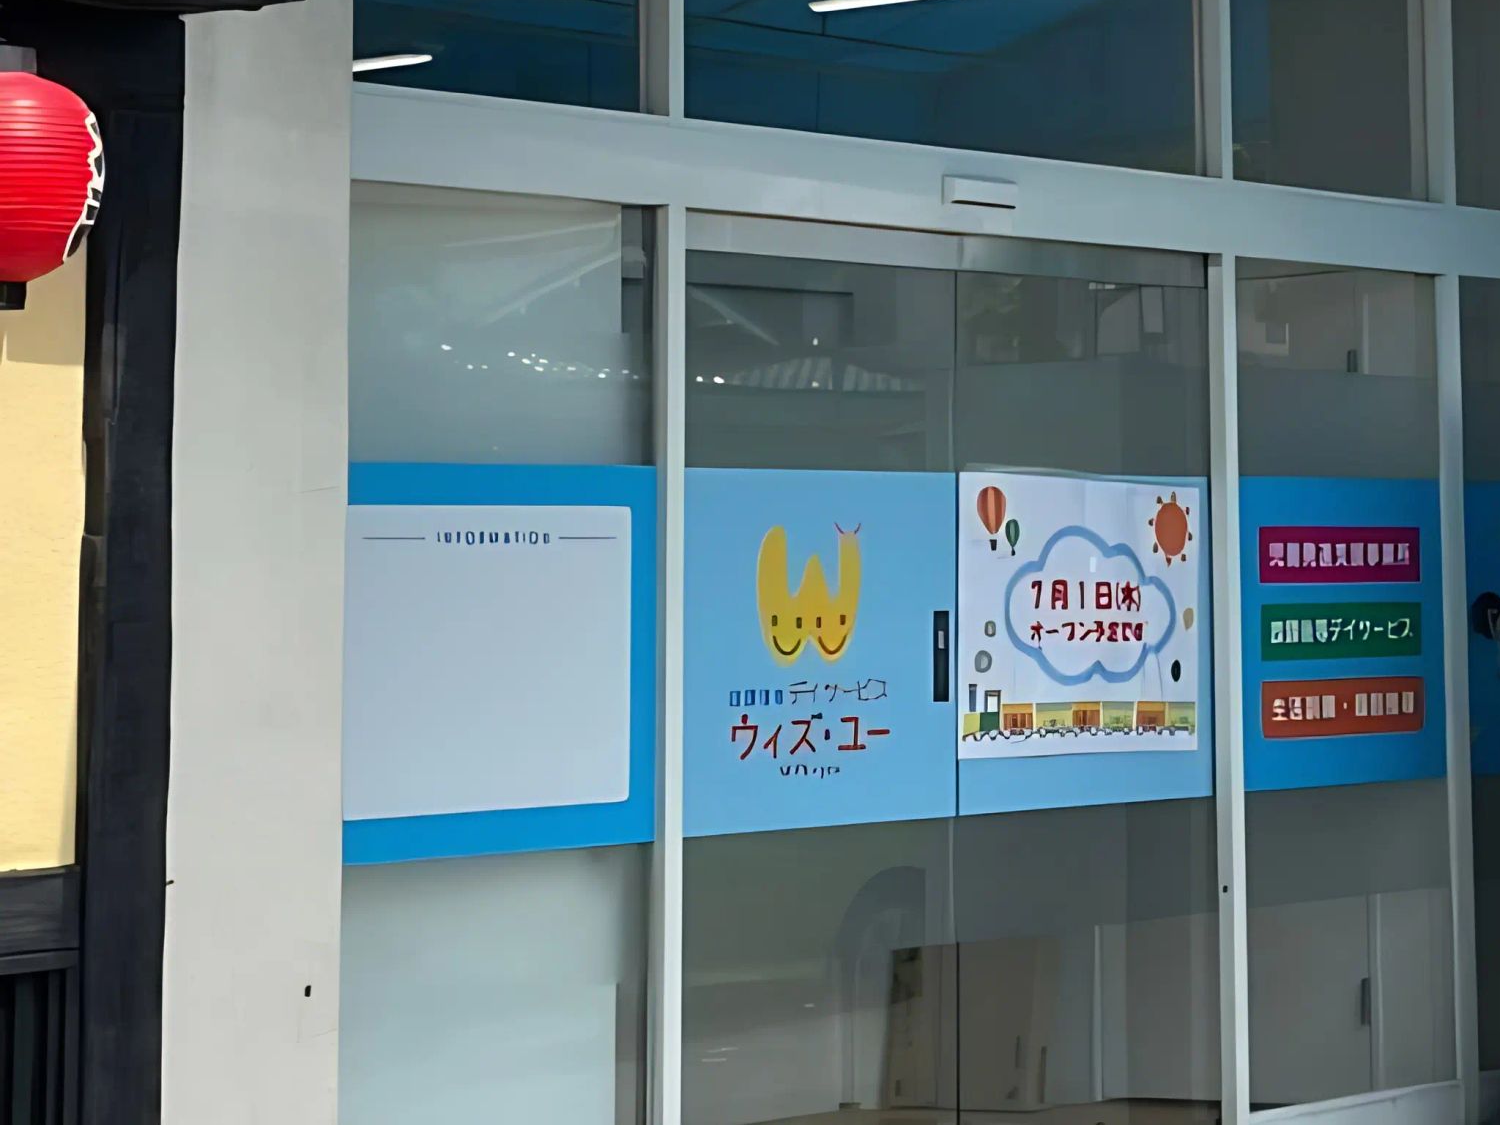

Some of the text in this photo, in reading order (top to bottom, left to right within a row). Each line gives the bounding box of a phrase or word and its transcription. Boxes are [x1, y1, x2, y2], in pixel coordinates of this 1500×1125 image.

[731, 712, 891, 760] ウィズ・ユー
